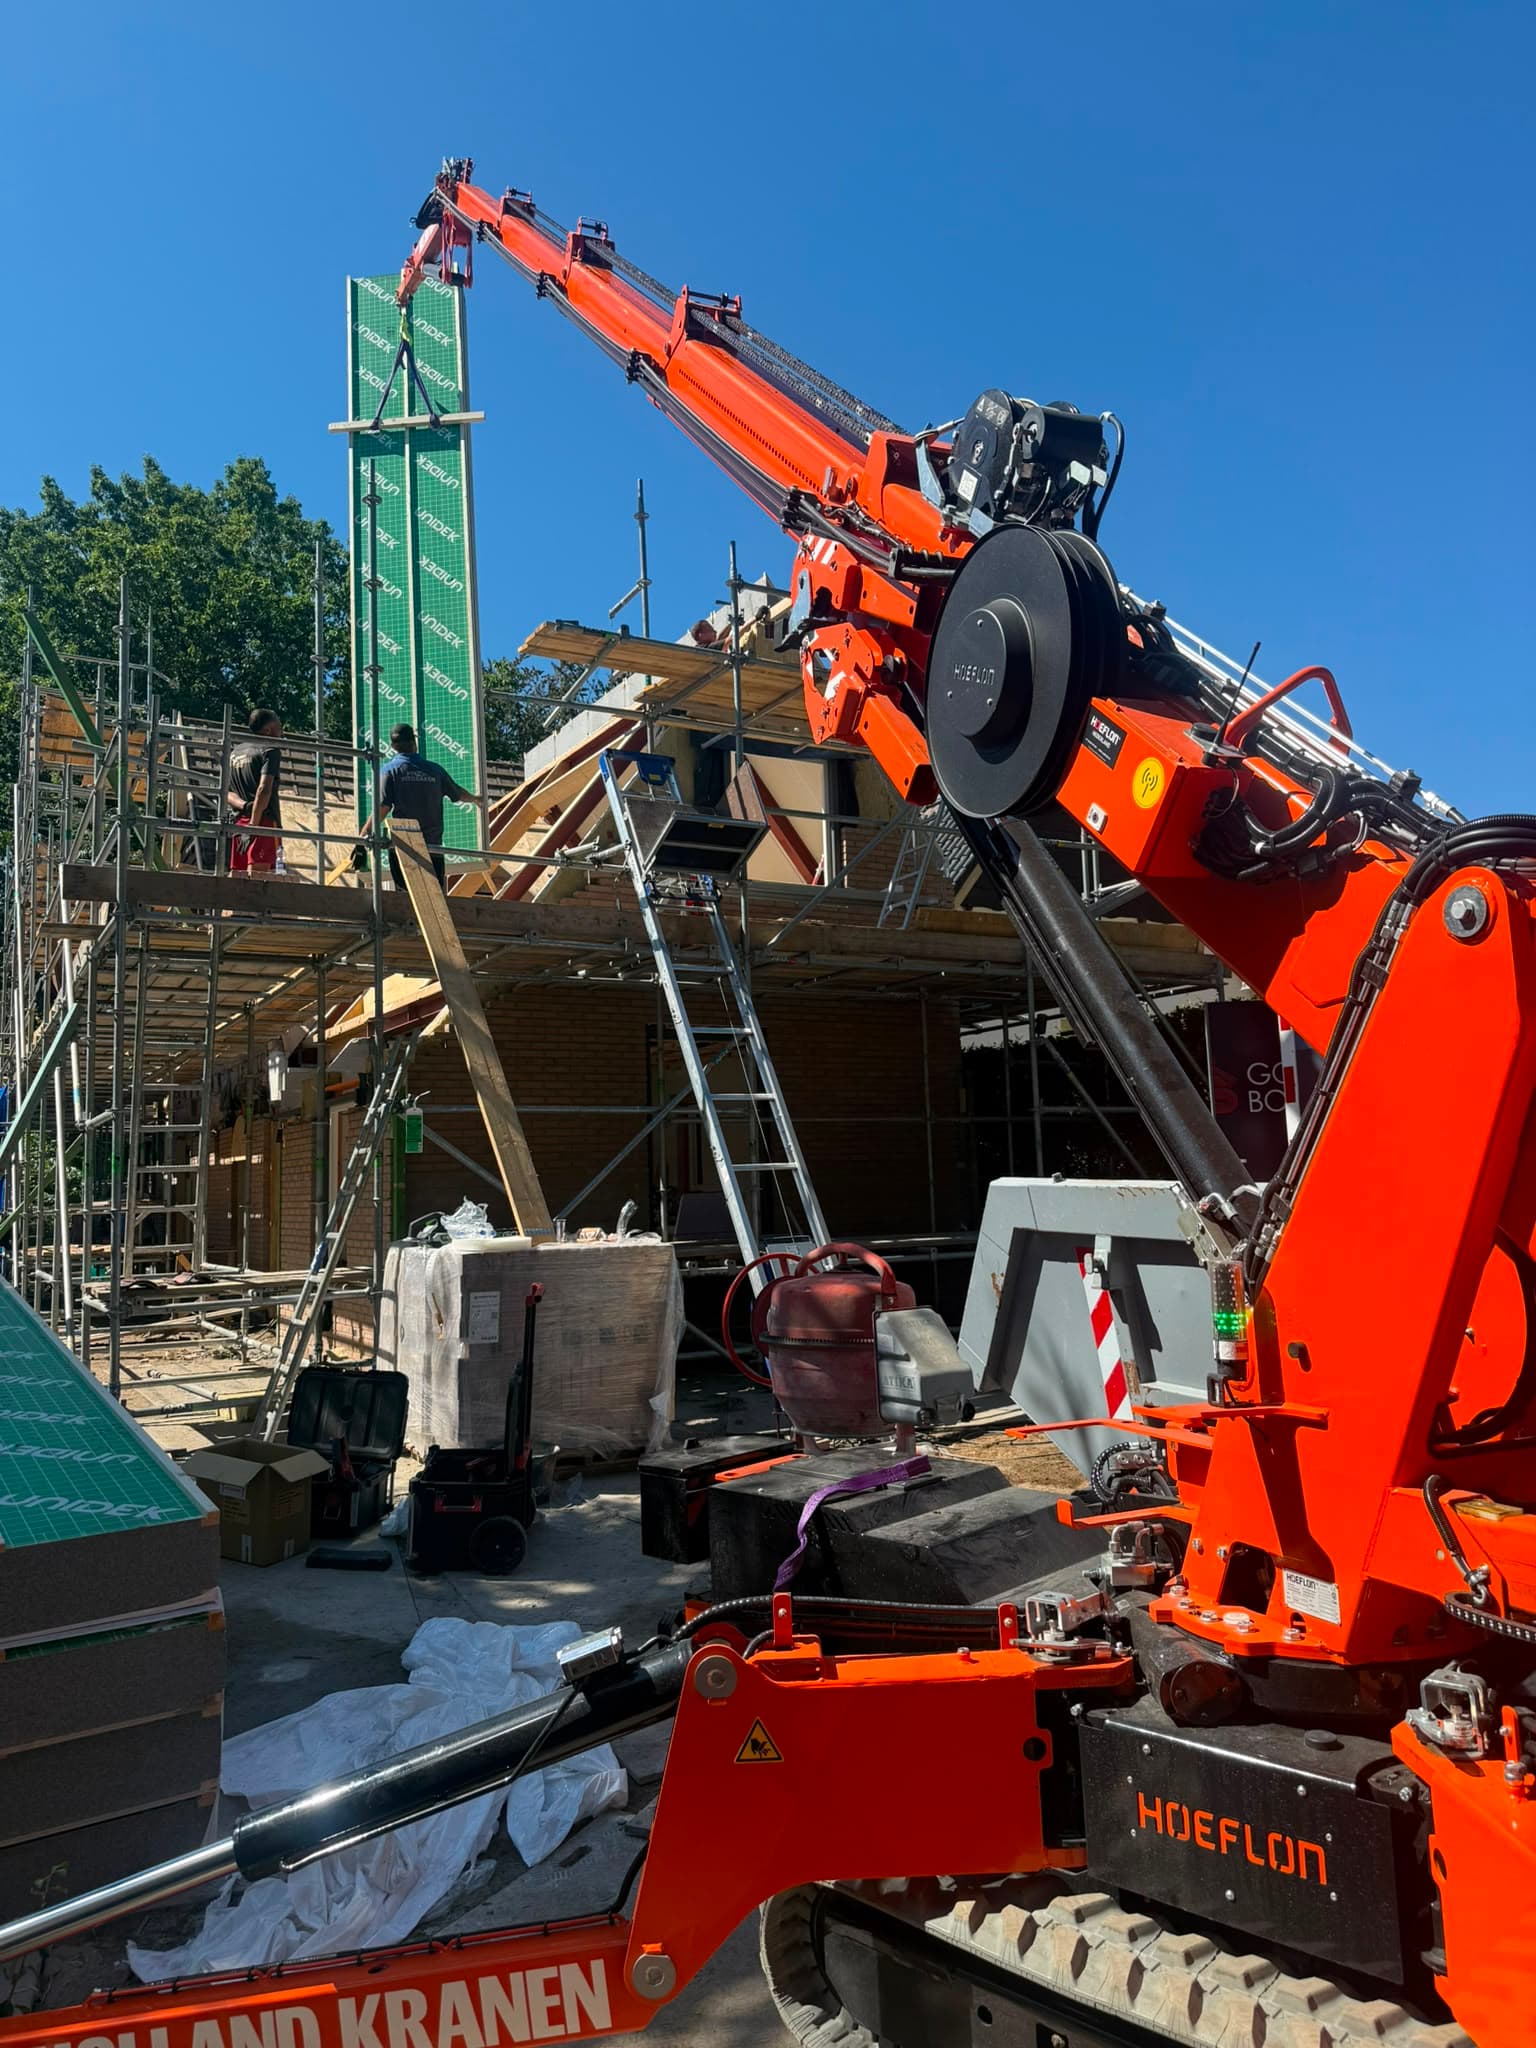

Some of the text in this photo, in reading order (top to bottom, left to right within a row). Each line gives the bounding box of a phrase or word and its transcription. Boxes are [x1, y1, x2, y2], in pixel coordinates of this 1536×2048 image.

[423, 276, 453, 298] UNID
[353, 321, 396, 354] UNIDEK
[410, 315, 453, 347] UNIDEK
[414, 358, 456, 392] UNIDEK
[416, 455, 459, 489] UNIDEK
[354, 514, 400, 550] UDEK
[415, 507, 460, 543] UNIDEK
[417, 555, 463, 592] UNIDEK
[356, 618, 403, 656] UDEK
[418, 610, 464, 649] UNIDEK
[422, 661, 468, 700] UNIDEK
[953, 664, 995, 686] HOEFLON
[422, 720, 470, 760] UNIDEK
[1091, 716, 1120, 745] HOEFLON
[1286, 1573, 1317, 1589] HOEFLON
[1137, 1791, 1327, 1886] HOEFLON
[338, 1958, 612, 2048] KRANEN
